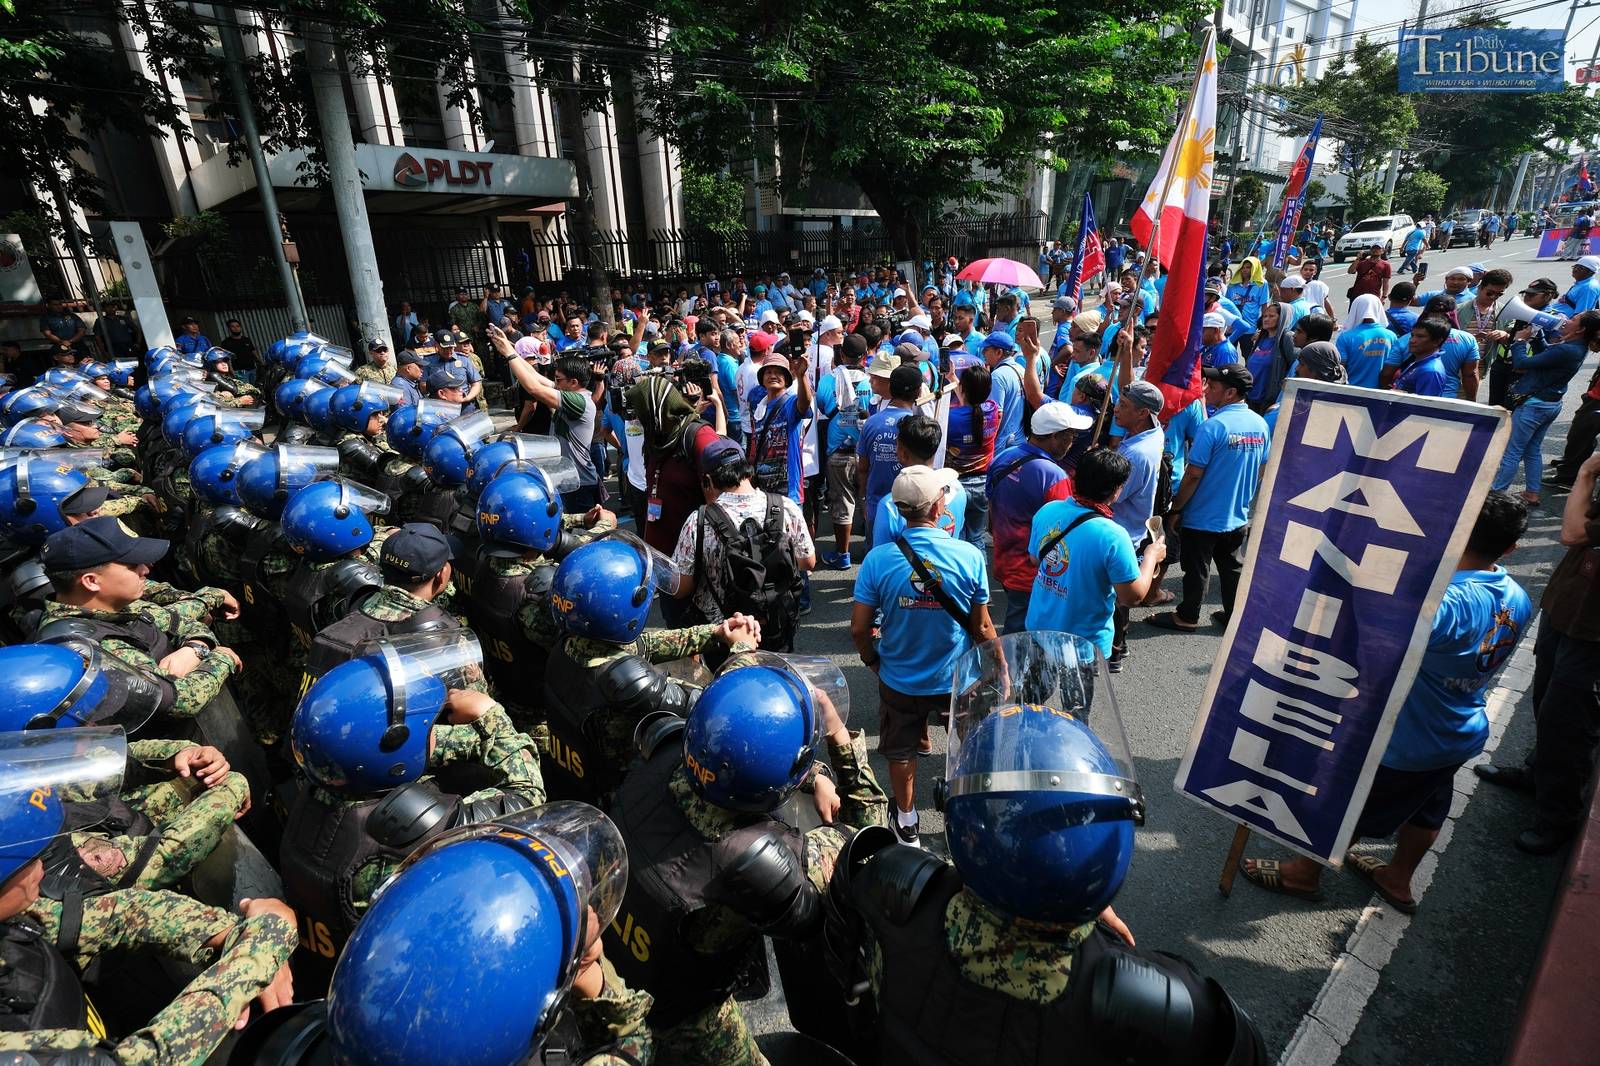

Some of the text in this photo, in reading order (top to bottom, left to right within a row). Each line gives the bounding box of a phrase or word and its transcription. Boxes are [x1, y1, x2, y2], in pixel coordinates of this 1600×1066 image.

[424, 158, 493, 186] PLDT
[1276, 200, 1296, 268] MANIBELA
[480, 512, 500, 525] PNP
[385, 553, 410, 568] PULIS
[552, 593, 573, 613] PNP
[1201, 400, 1474, 845] MANIBELA
[687, 753, 716, 785] PNP
